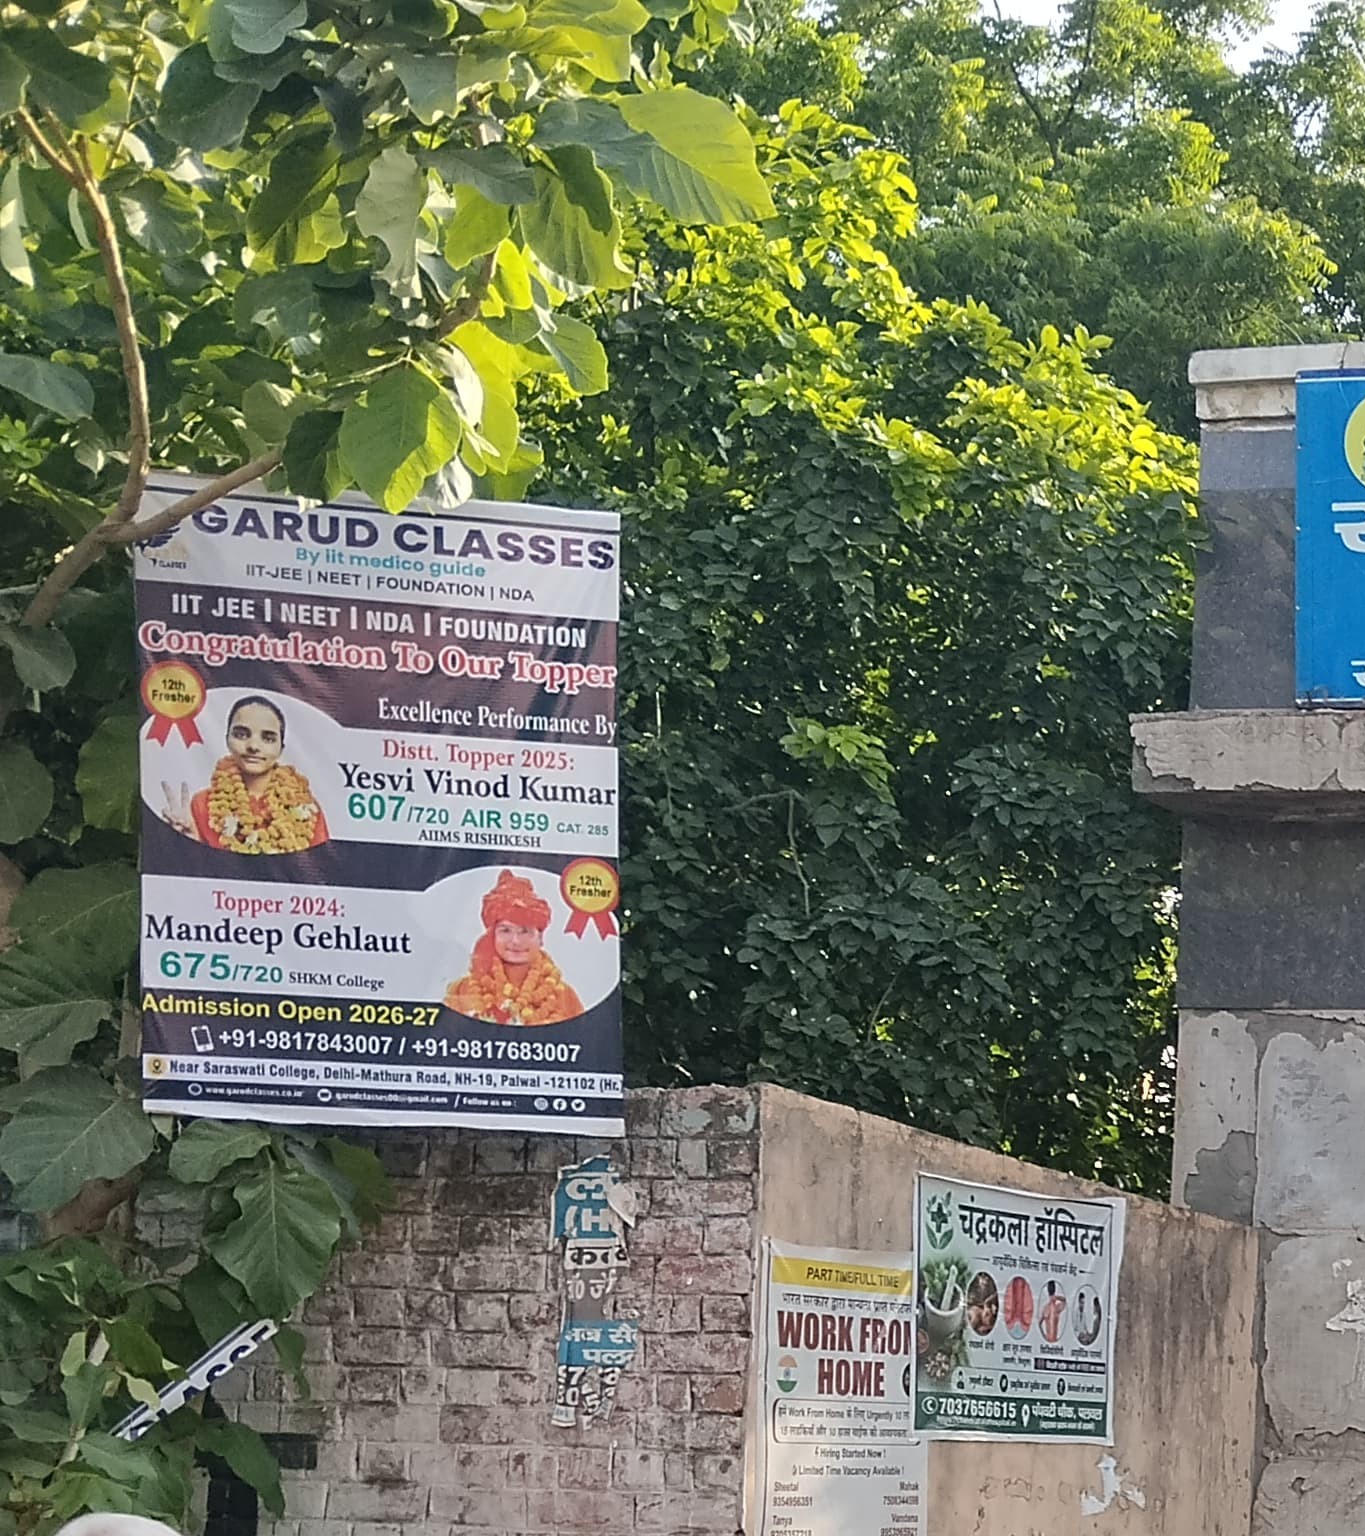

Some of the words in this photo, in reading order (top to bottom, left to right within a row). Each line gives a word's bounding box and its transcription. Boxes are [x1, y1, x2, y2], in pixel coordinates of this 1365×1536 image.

[192, 503, 379, 548] GARUD
[393, 523, 615, 572] CLASSES
[296, 547, 319, 566] By
[324, 550, 346, 568] iit
[350, 552, 426, 575] medico
[429, 559, 487, 579] guide
[246, 563, 302, 582] IIT-JEE
[317, 569, 362, 588] NEET
[376, 575, 486, 599] FOUNDATION
[499, 586, 535, 603] NDA
[171, 593, 203, 616] IIT
[212, 595, 255, 619] JEE
[280, 602, 339, 628] NEET
[366, 609, 414, 634] NDA
[440, 616, 587, 649] FOUNDATION
[139, 620, 388, 668] Congratulation
[392, 640, 433, 673] To
[438, 646, 502, 680] Our
[509, 650, 617, 695] Topper
[152, 690, 196, 704] Fresher
[161, 679, 186, 692] 12th
[378, 698, 472, 726] Excellence
[477, 705, 590, 735] Performance
[595, 714, 617, 743] By
[382, 738, 439, 762] Distt.
[446, 743, 515, 771] Topper
[521, 749, 575, 771] 2025:
[338, 762, 415, 793] Yesvi
[423, 769, 510, 798] Vinod
[520, 776, 617, 806] Kumar
[348, 793, 450, 825] 607/720
[461, 809, 501, 829] AIR
[510, 812, 549, 832] 959
[418, 829, 460, 844] AIIMS
[464, 832, 541, 848] RISHIKESH
[570, 885, 611, 898] Fresher
[580, 875, 602, 886] 12th
[212, 891, 283, 919] Topper
[290, 896, 345, 918] 2024:
[145, 913, 283, 955] Mandeep
[293, 922, 413, 954] Gehlaut
[160, 951, 283, 984] 675/720
[289, 972, 332, 986] SHKM
[336, 974, 385, 990] College
[142, 994, 271, 1018] Admission
[277, 1000, 342, 1023] Open
[349, 1004, 440, 1026] 2026-27
[218, 1028, 393, 1055] +91-9817843007
[411, 1038, 582, 1063] +91-9817683007
[169, 1060, 199, 1074] Near
[203, 1061, 265, 1077] Saraswati
[501, 1076, 540, 1088] Palwal
[958, 1194, 1030, 1246] चंद्रकला
[1035, 1207, 1104, 1256] हॉस्पिटल
[806, 1267, 833, 1281] PART
[879, 1275, 899, 1288] TIME
[777, 1310, 854, 1352] WORK
[818, 1358, 885, 1397] HOME
[939, 1398, 1017, 1419] 7037656615
